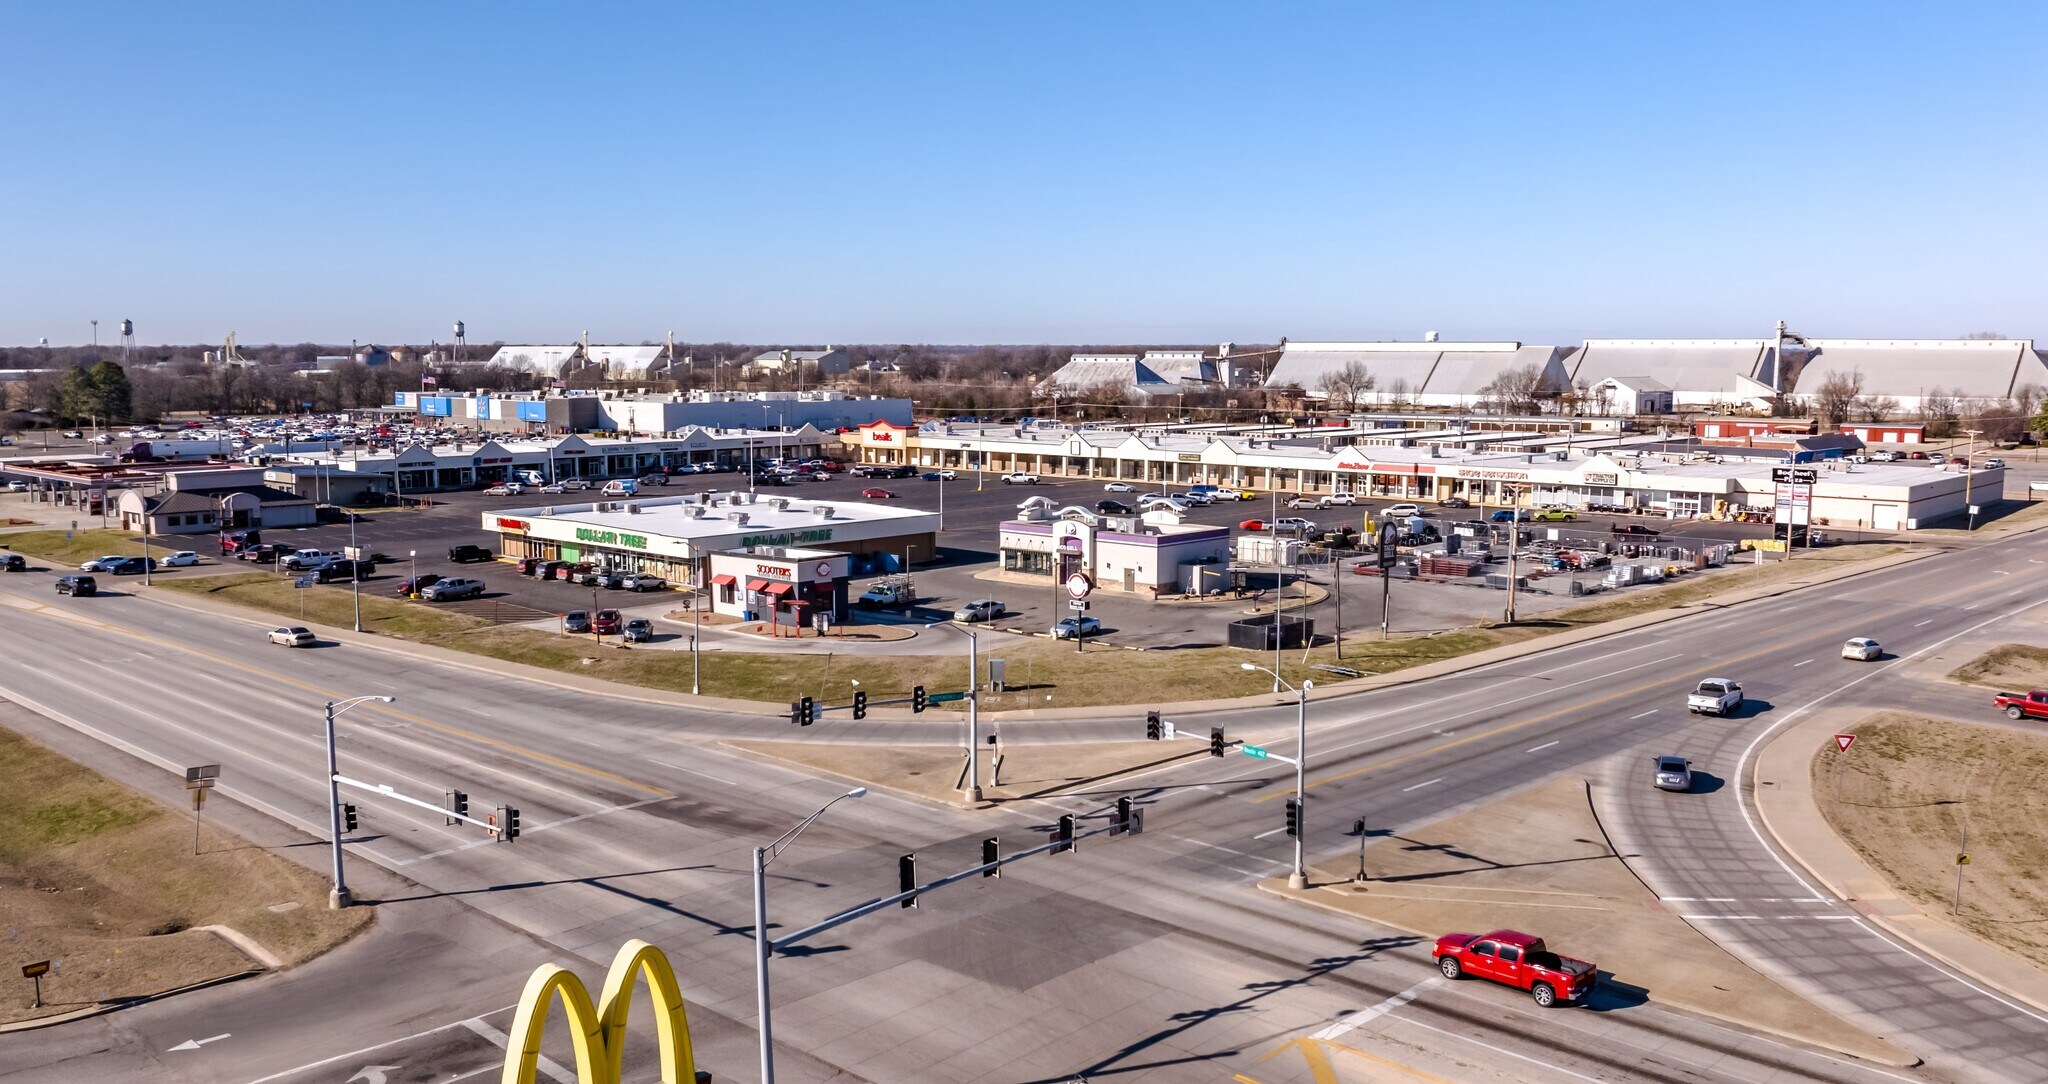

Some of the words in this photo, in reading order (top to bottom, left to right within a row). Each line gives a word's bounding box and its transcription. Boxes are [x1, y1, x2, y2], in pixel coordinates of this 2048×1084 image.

[576, 527, 618, 545] DOLLAR
[619, 533, 647, 549] TREE
[741, 532, 793, 547] DOLLAR
[801, 528, 833, 543] TREE
